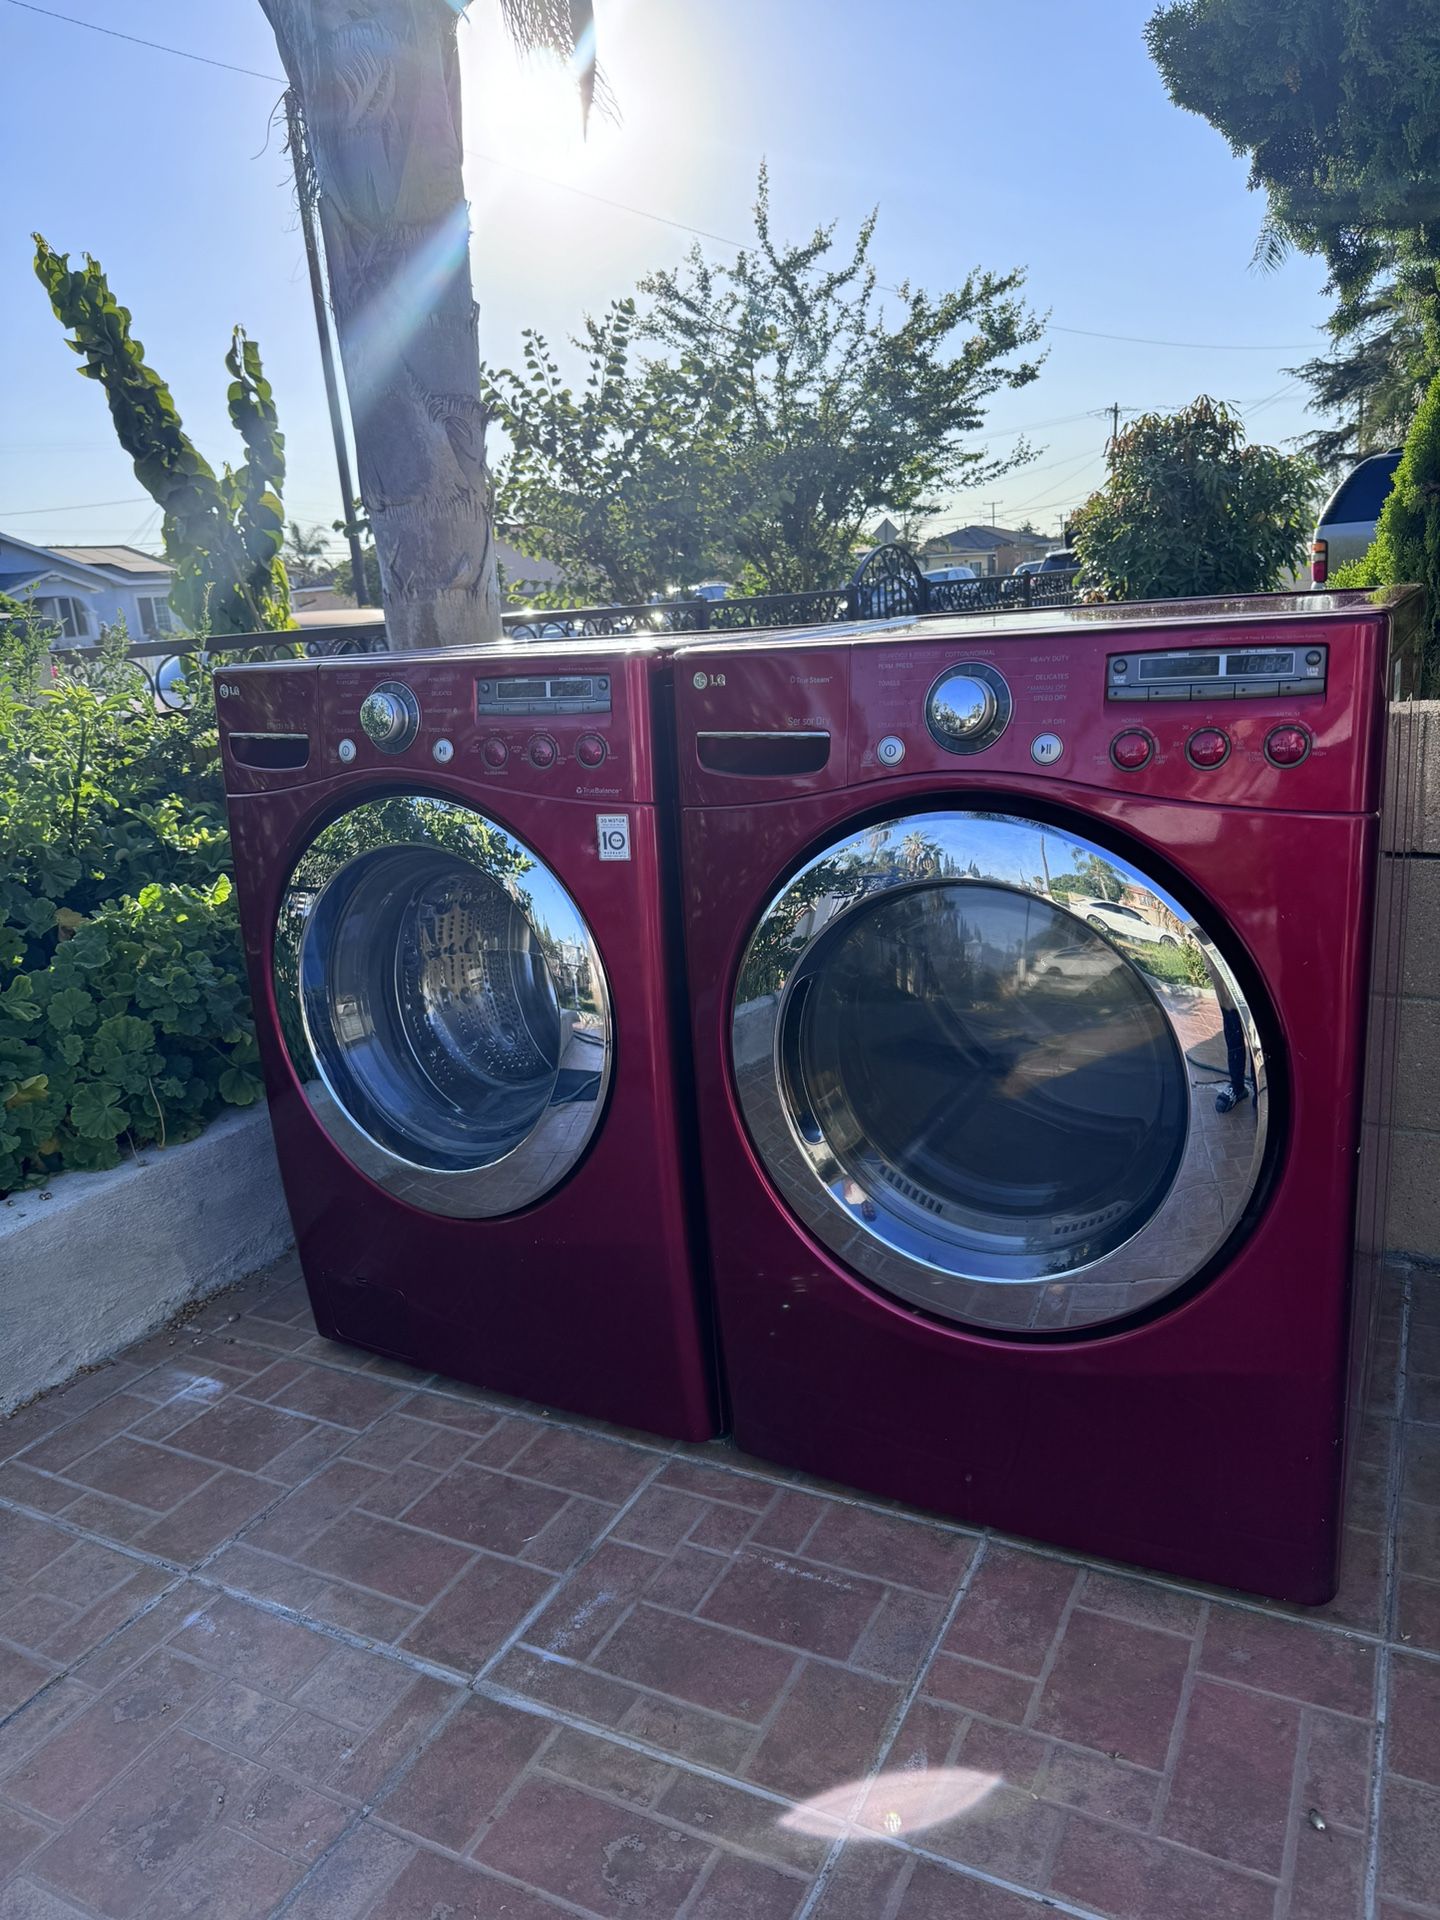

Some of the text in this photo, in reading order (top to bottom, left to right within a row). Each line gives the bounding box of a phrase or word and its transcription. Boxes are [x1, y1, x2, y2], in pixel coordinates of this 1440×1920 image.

[1030, 654, 1070, 663] HEAVY DUTY
[709, 673, 727, 687] LG
[1035, 673, 1070, 681] DELICATES
[229, 685, 241, 697] LG
[602, 831, 626, 851] 10
